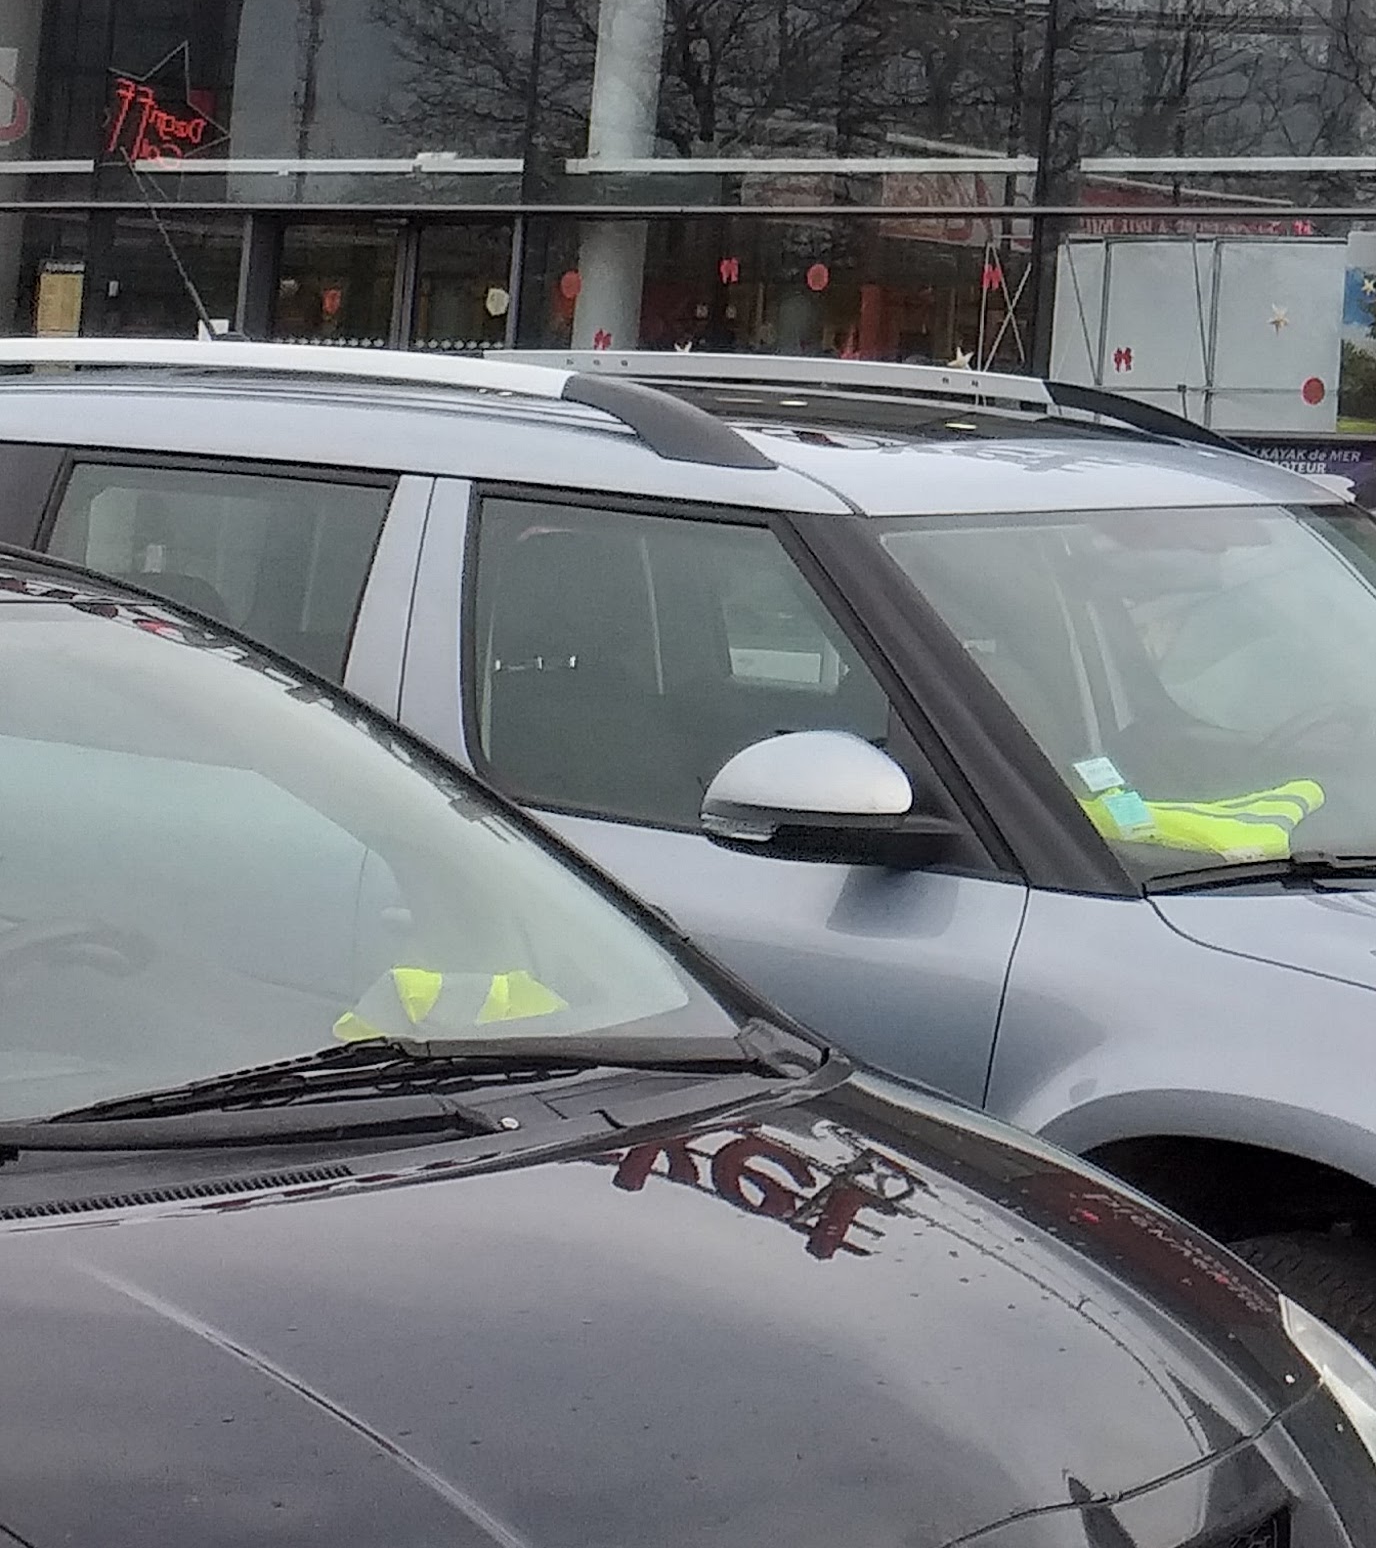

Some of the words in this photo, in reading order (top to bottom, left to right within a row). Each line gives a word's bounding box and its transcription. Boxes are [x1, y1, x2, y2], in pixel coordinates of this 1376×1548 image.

[1260, 447, 1307, 461] KAYAK
[1309, 449, 1326, 461] de
[1329, 451, 1361, 462] MER
